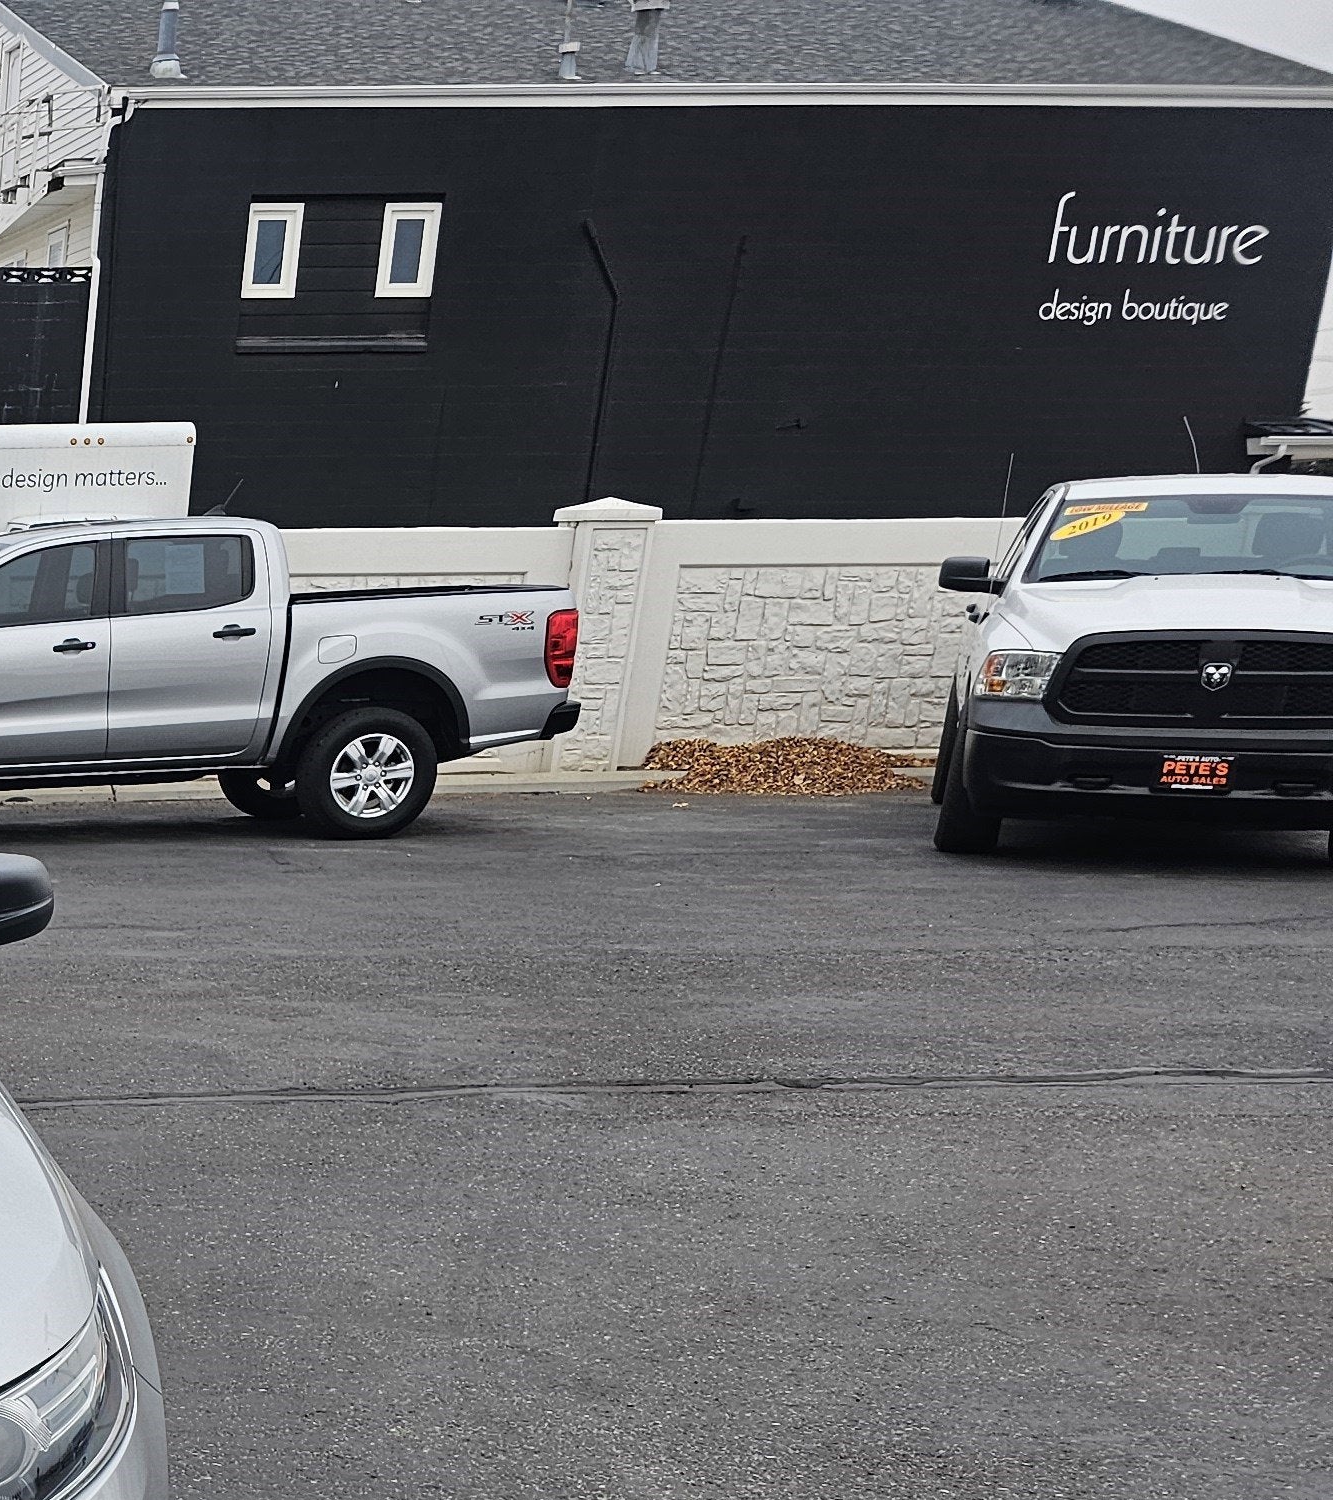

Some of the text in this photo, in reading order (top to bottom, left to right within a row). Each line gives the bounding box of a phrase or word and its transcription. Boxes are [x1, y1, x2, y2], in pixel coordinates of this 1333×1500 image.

[1047, 190, 1270, 266] furniture
[1038, 287, 1230, 326] design boutique
[1, 467, 168, 493] design matters...
[1067, 513, 1112, 535] 2019
[474, 610, 535, 626] STX
[1162, 761, 1229, 776] PETE'S
[1192, 777, 1227, 785] SALES
